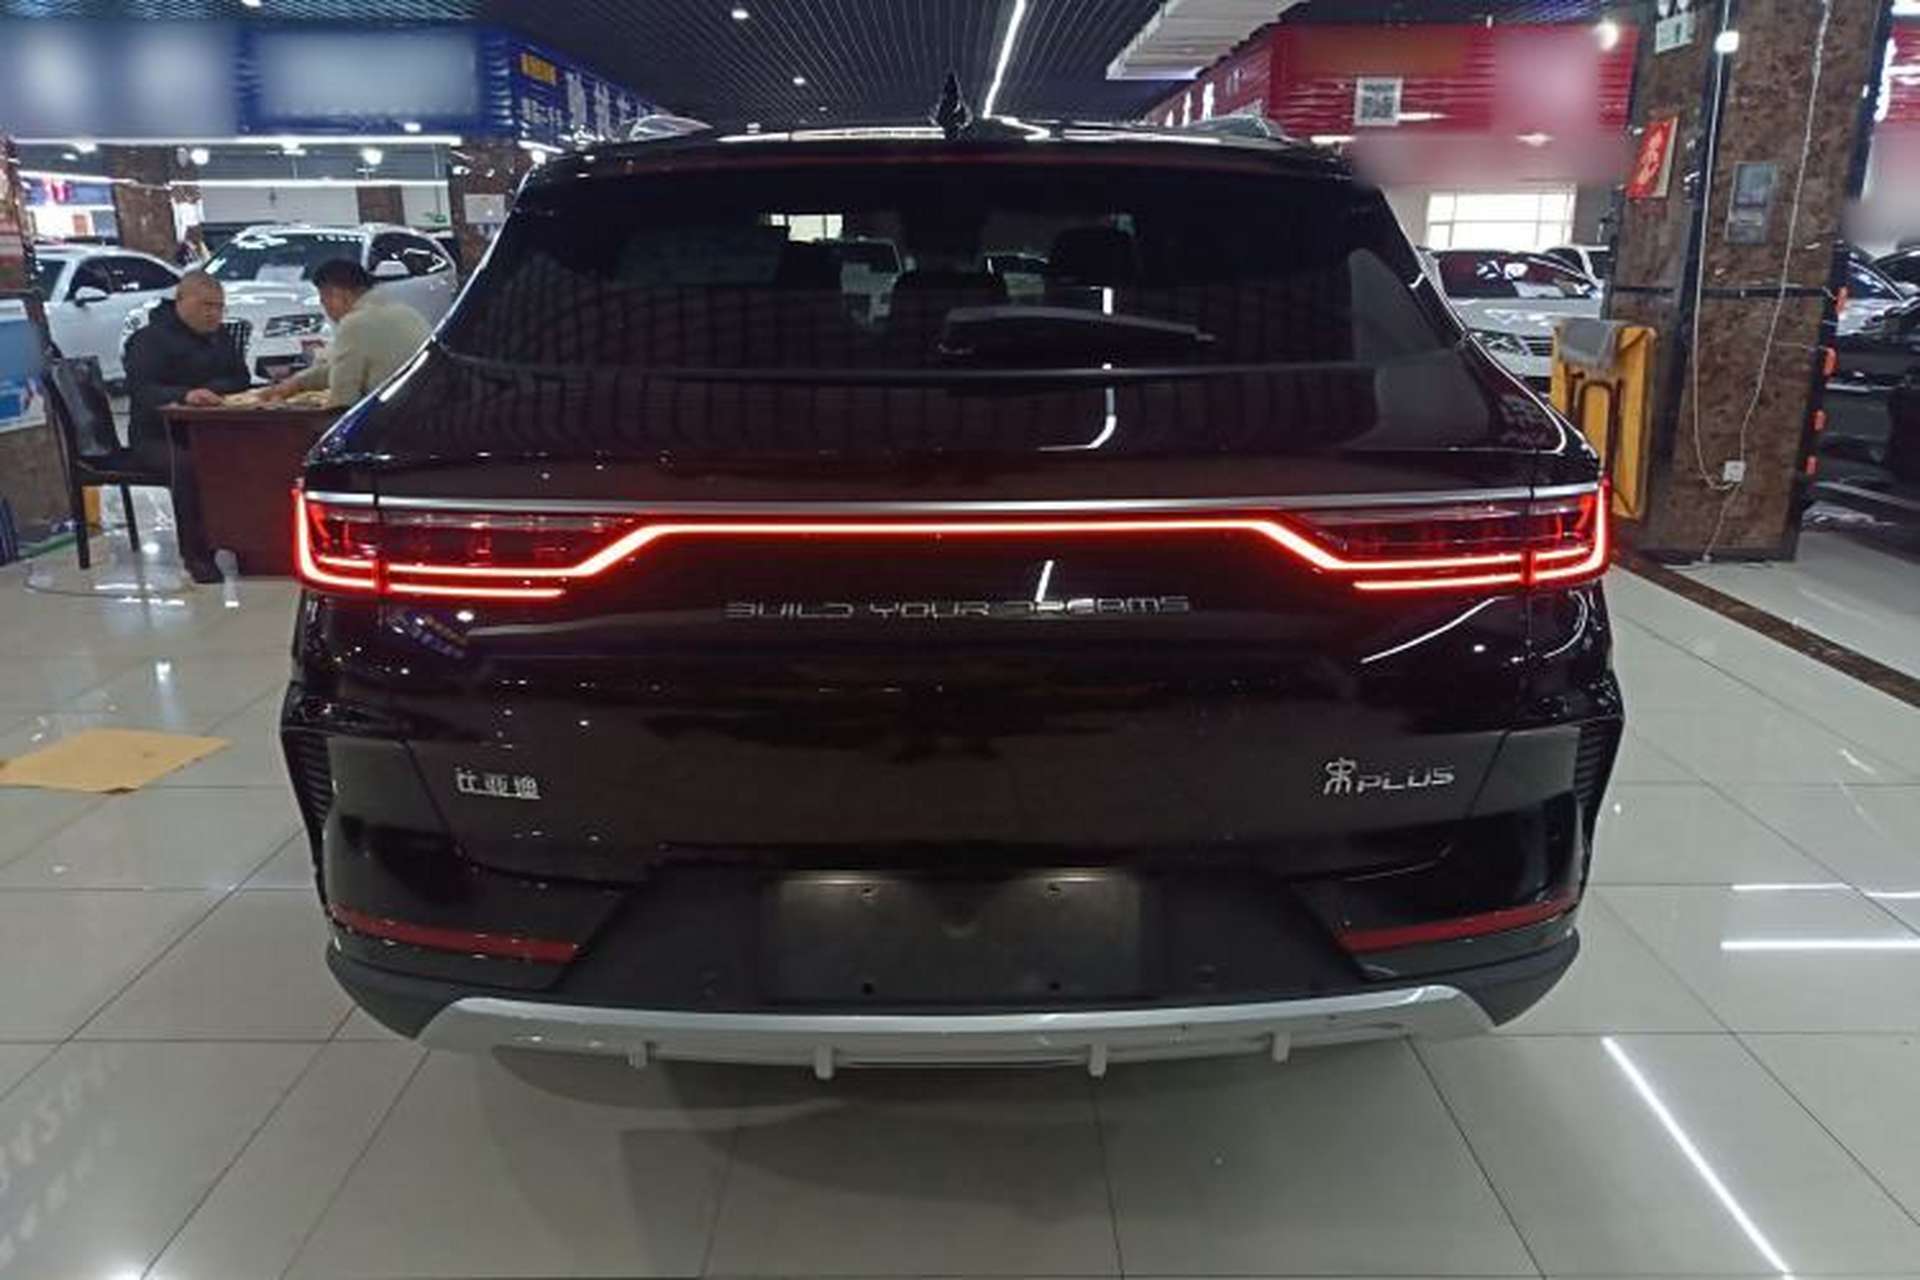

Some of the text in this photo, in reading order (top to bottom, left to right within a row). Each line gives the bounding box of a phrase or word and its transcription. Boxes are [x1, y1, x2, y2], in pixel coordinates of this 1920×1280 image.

[724, 596, 1190, 618] BUILD YOUR DREAMS
